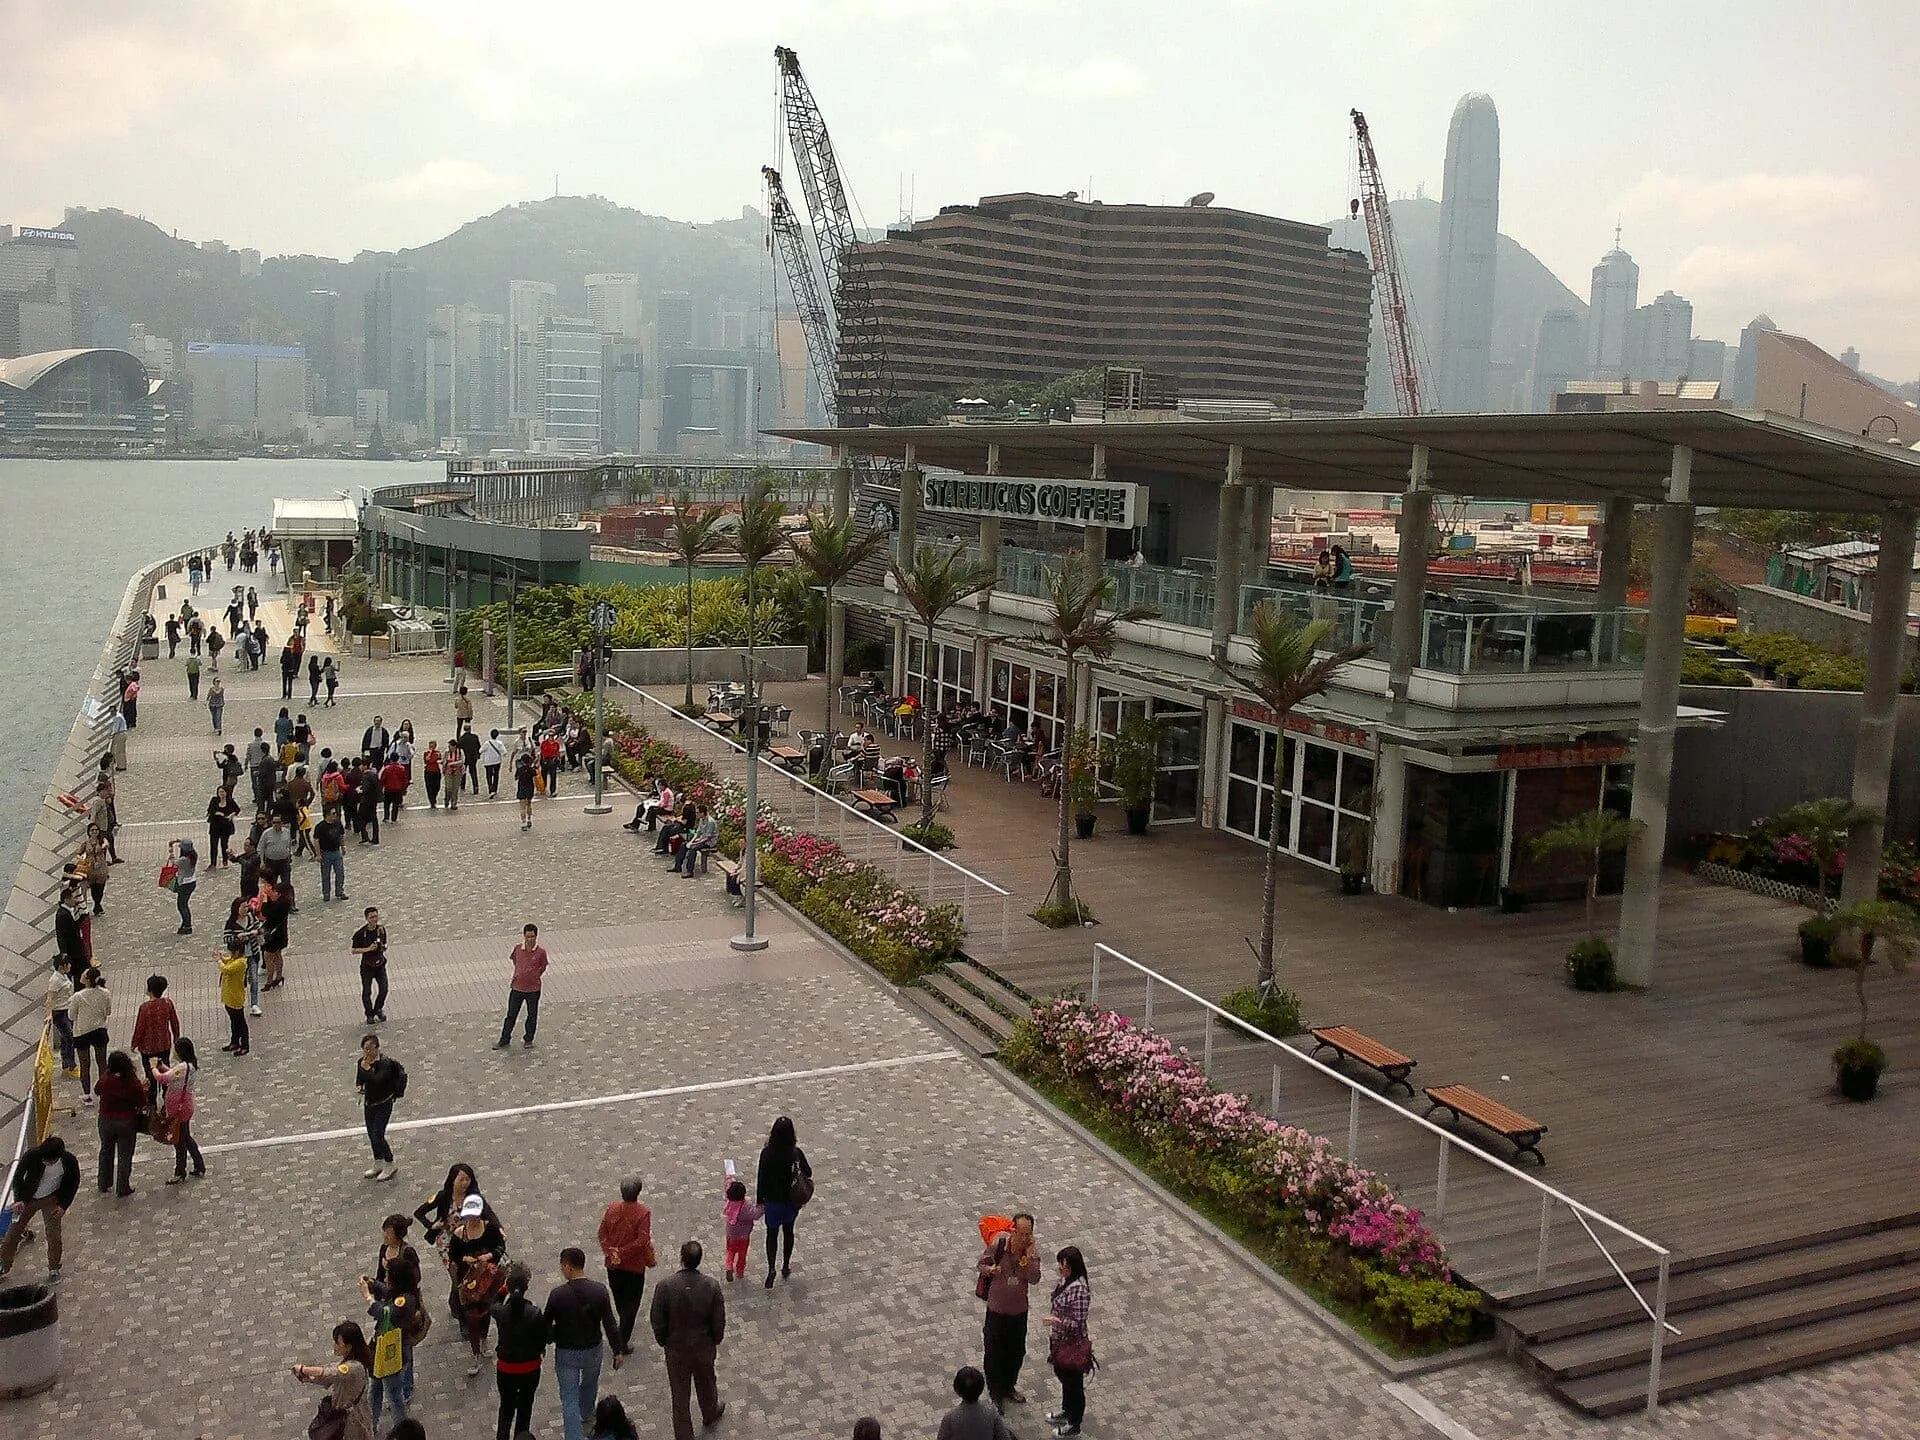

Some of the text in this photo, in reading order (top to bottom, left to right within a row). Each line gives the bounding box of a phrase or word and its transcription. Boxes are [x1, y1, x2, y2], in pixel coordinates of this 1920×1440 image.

[36, 230, 74, 240] HYUNDAI
[926, 478, 1127, 523] STARBUCKS COFFEE
